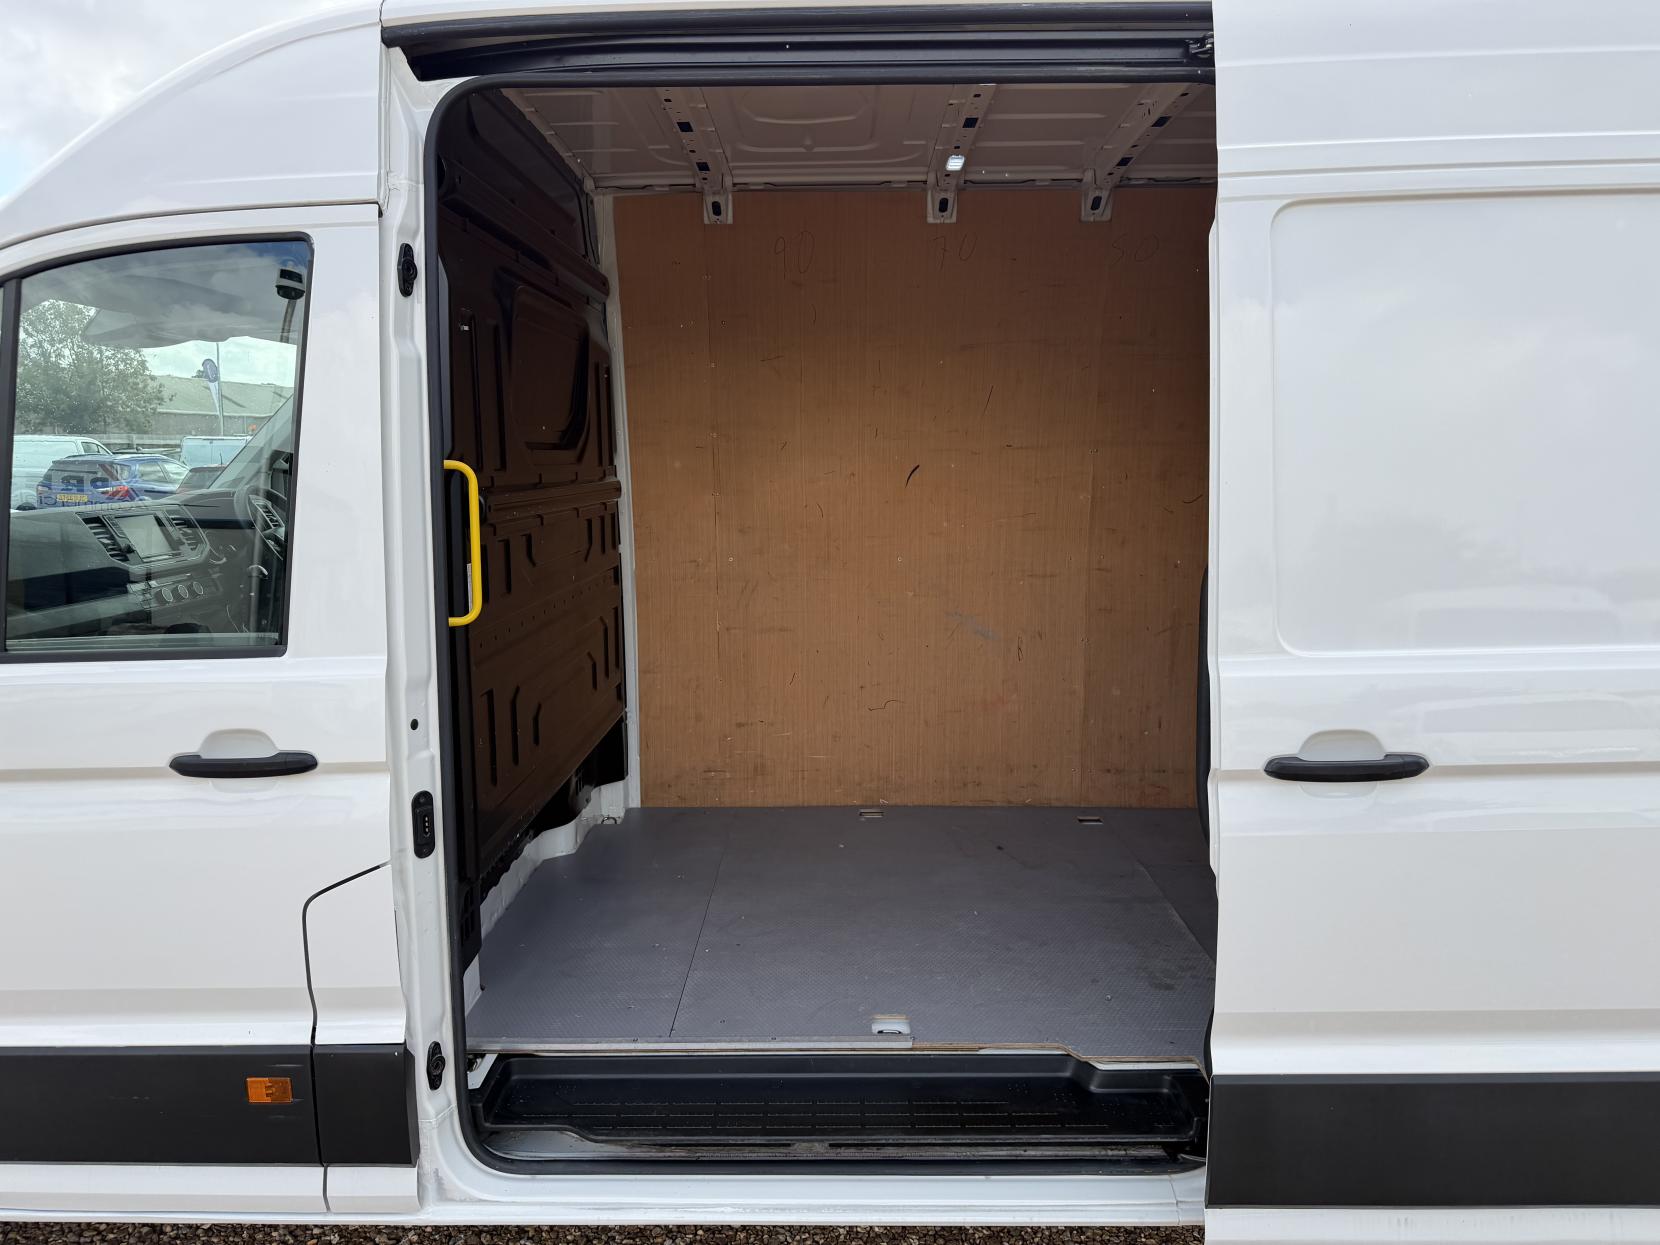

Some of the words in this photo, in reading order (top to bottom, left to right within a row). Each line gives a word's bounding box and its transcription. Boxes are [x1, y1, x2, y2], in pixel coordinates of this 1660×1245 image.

[774, 230, 816, 280] 90
[932, 232, 978, 271] 70
[1109, 232, 1160, 271] 50
